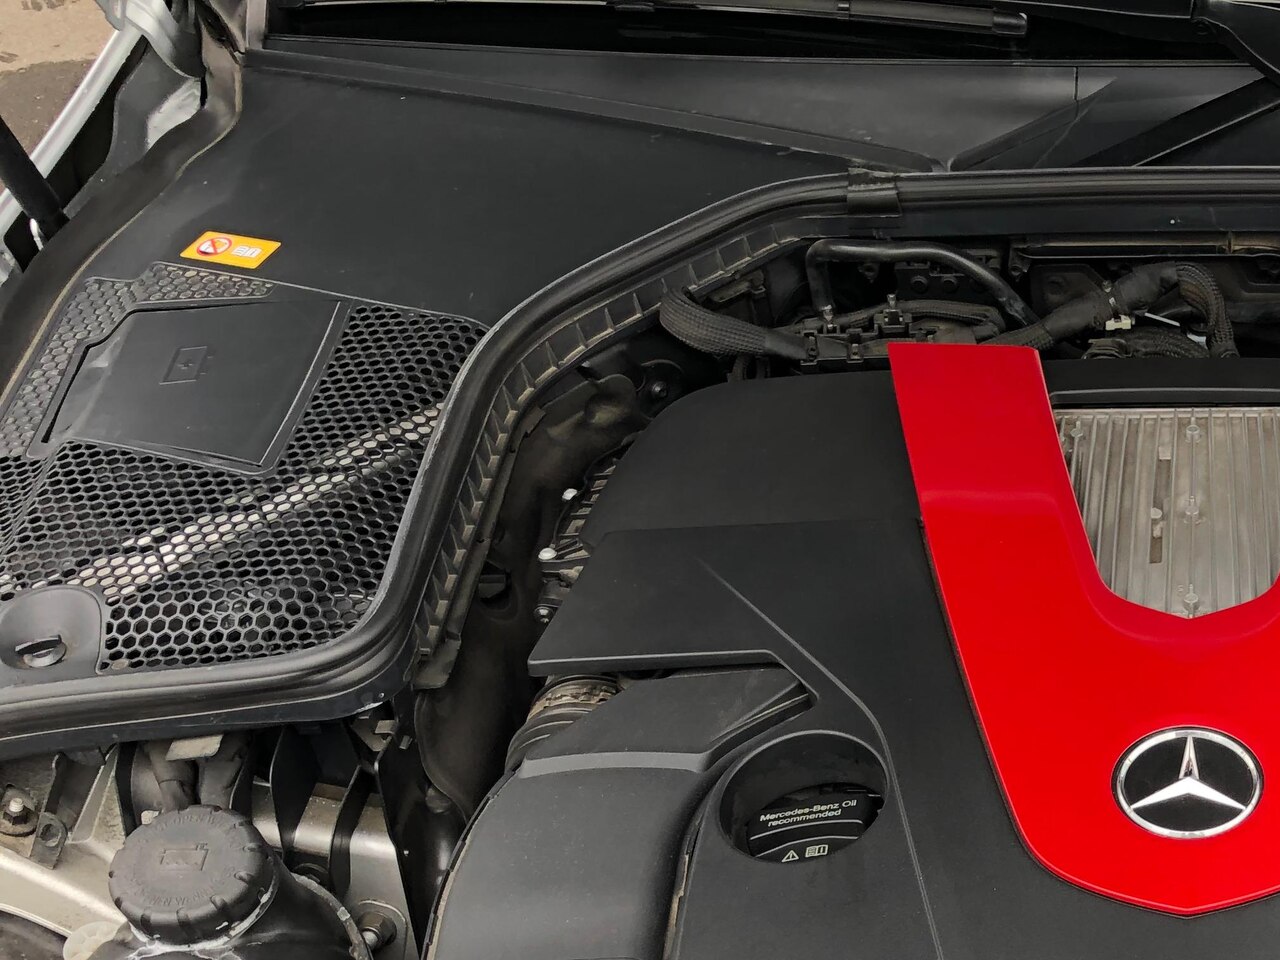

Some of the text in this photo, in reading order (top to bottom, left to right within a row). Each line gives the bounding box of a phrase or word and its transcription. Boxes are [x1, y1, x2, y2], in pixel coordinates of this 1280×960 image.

[759, 799, 857, 823] Mercedes-Benz Oil
[767, 808, 842, 828] recommended
